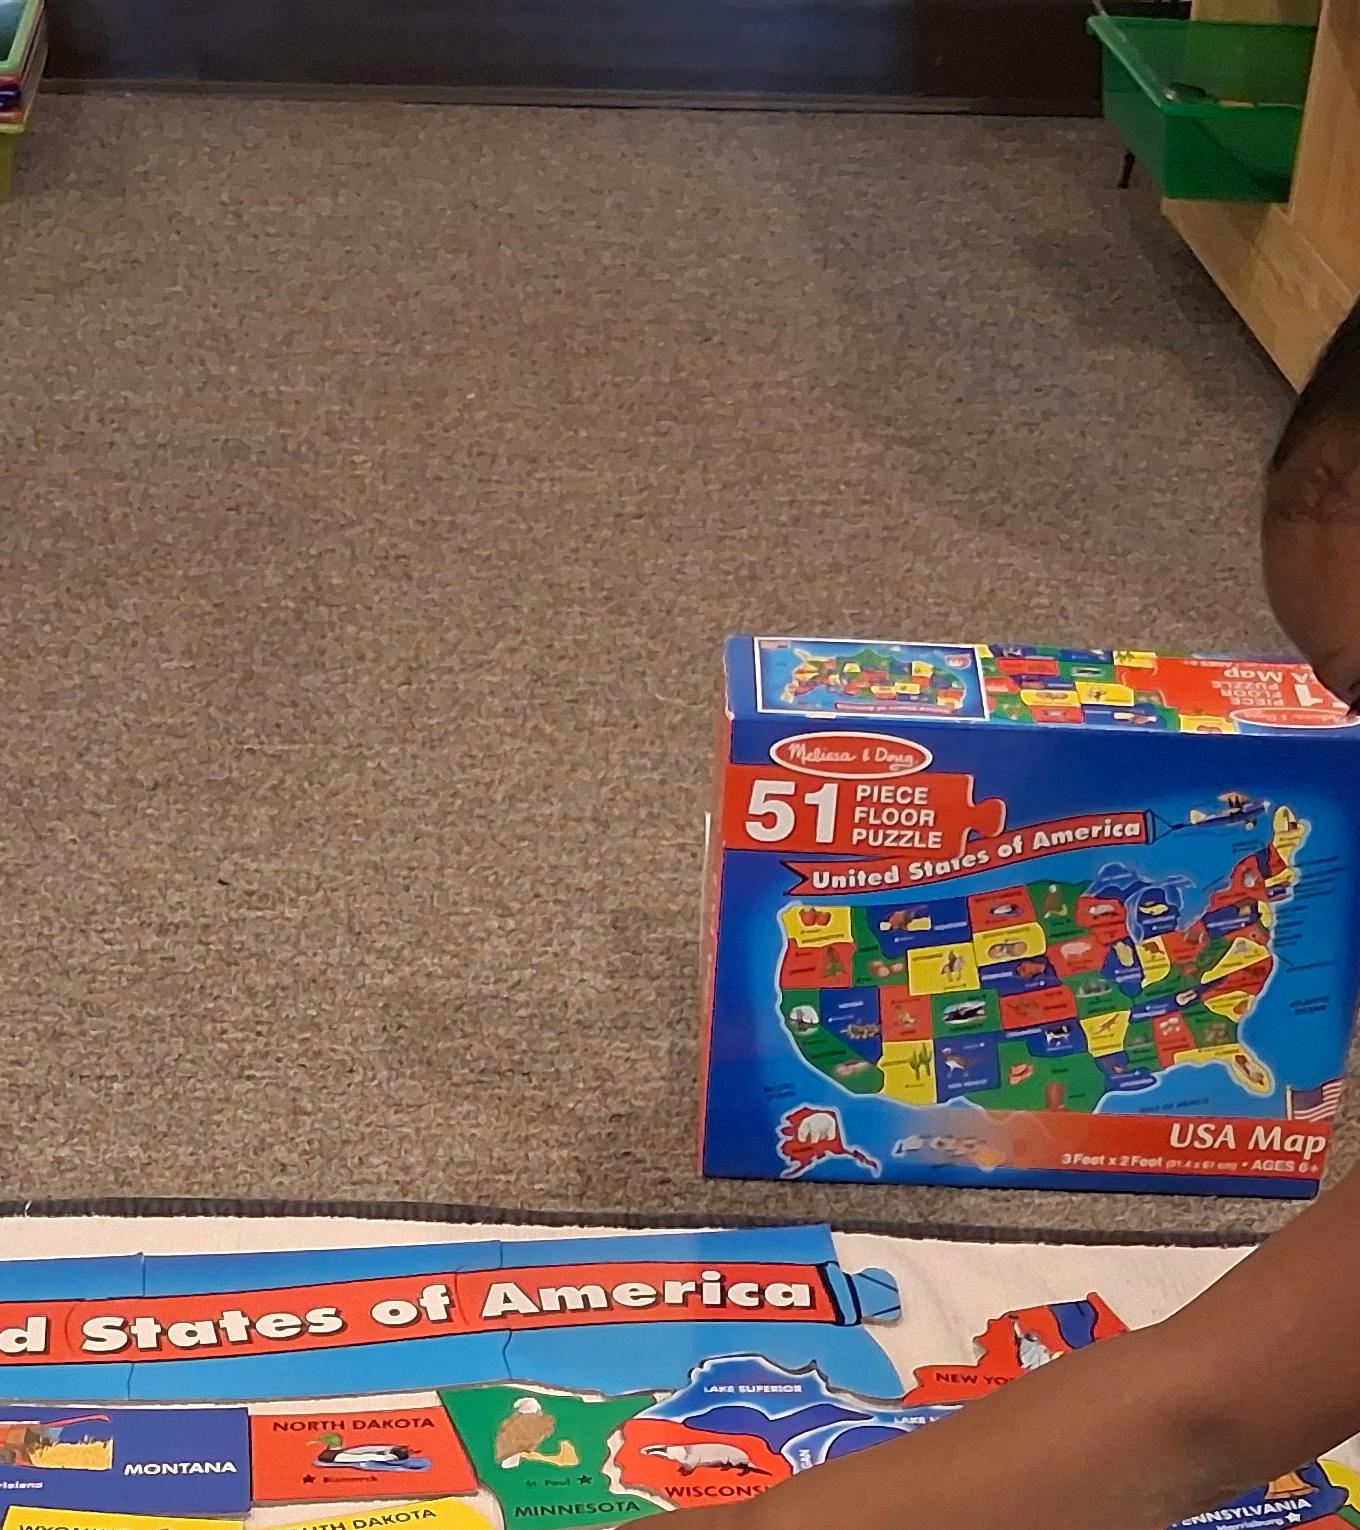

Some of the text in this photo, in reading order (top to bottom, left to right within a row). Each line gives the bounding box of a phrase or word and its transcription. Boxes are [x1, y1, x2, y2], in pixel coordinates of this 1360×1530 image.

[1223, 667, 1283, 681] Map
[789, 742, 855, 764] Melissa
[875, 747, 916, 770] Doug
[856, 784, 929, 805] PIECE
[745, 779, 838, 843] 51
[853, 807, 935, 827] FLOOR
[851, 828, 943, 849] PUZZLE
[812, 818, 1141, 889] United States of America
[1169, 1122, 1326, 1160] USA Map
[1061, 1153, 1071, 1165] 3
[1073, 1154, 1105, 1166] Feet
[1108, 1157, 1116, 1166] x
[1119, 1155, 1129, 1166] 2
[1130, 1156, 1163, 1168] Feet
[1251, 1160, 1295, 1172] AGES
[1298, 1162, 1320, 1173] 6+
[81, 1304, 343, 1353] States
[371, 1282, 449, 1329] of
[481, 1269, 811, 1319] America
[703, 1384, 802, 1393] LAKE SUPERIOR
[935, 1372, 1015, 1386] NEW YO
[273, 1417, 435, 1432] NORTH DAKOTA
[124, 1461, 238, 1476] MONTANA
[352, 1507, 436, 1530] DAKOTA
[514, 1500, 641, 1518] MINNESOTA
[1171, 1498, 1312, 1528] ENNSYLVANIA
